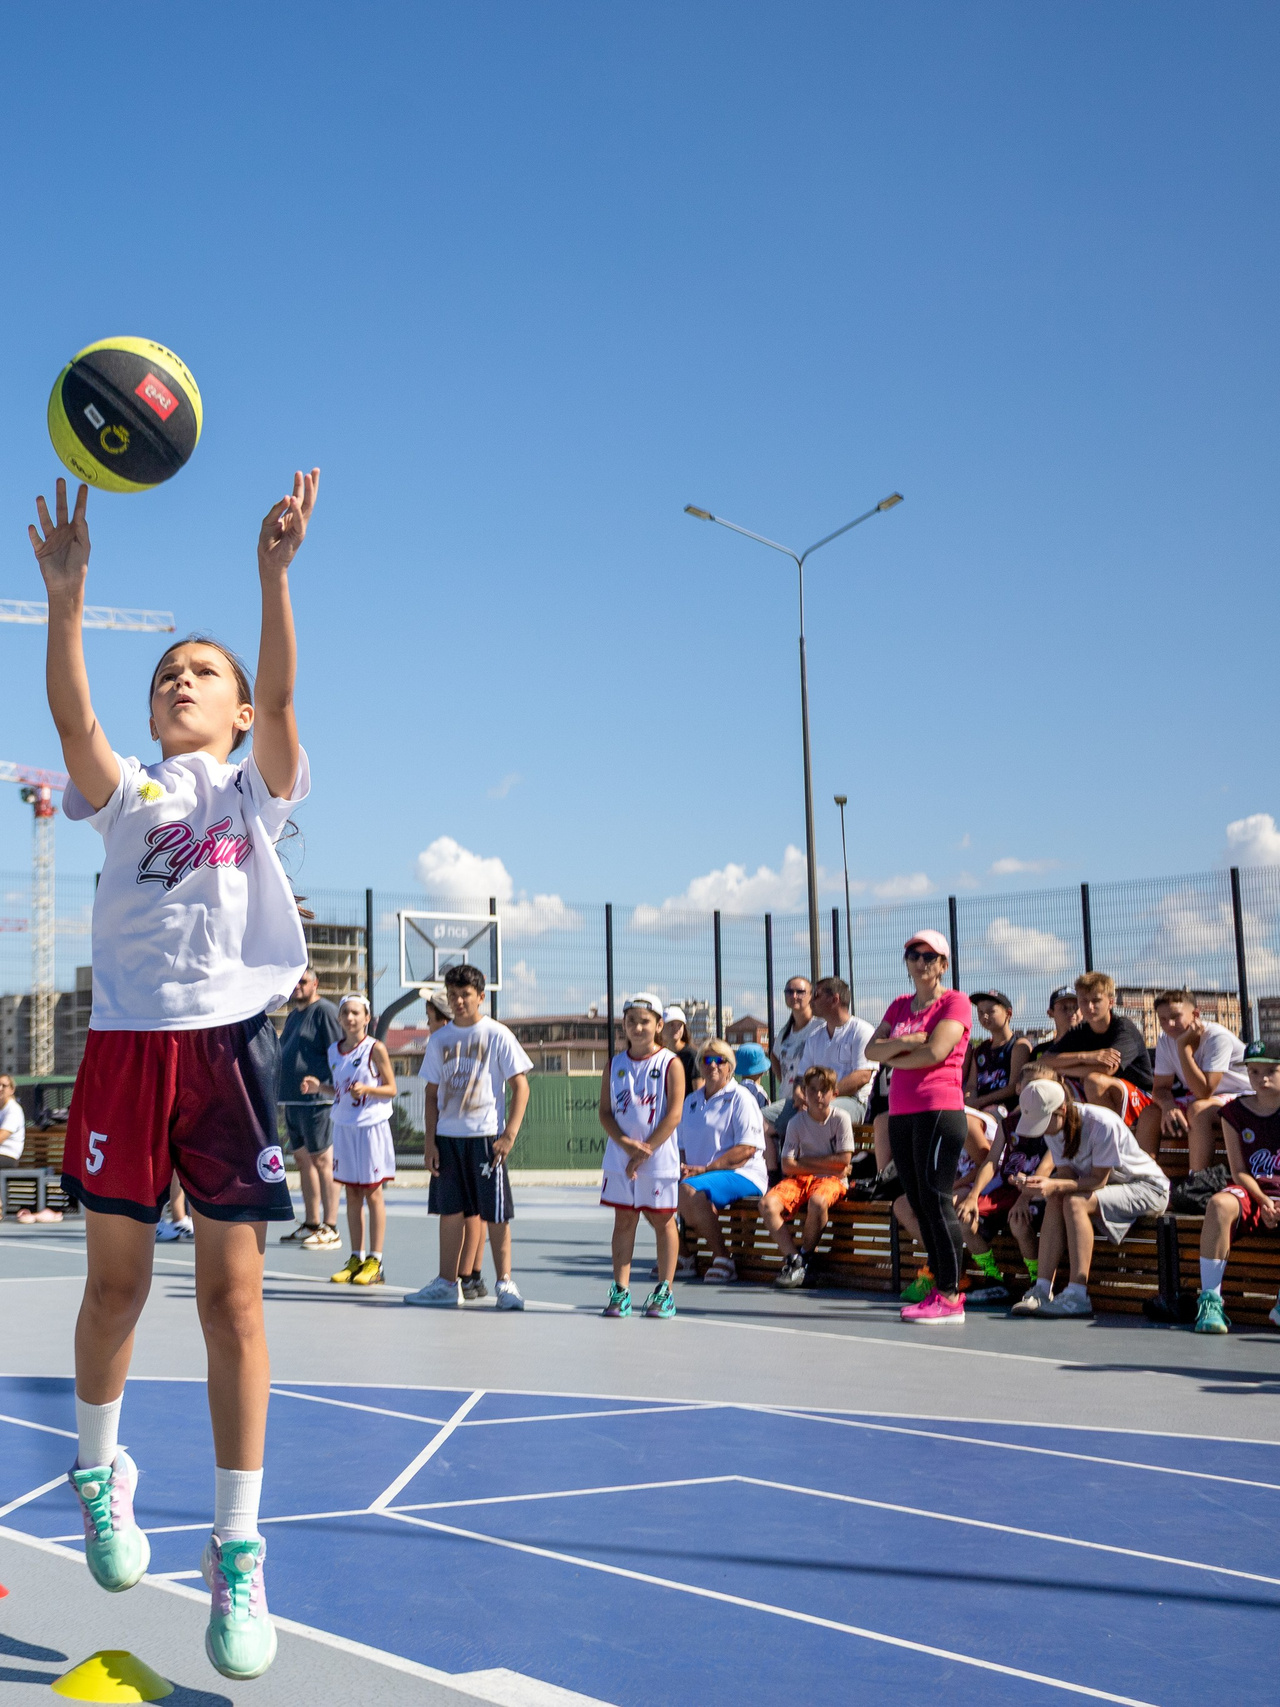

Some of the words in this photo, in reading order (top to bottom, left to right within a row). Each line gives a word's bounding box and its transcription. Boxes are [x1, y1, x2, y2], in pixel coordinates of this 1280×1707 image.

[136, 816, 253, 891] Рубин
[647, 1108, 656, 1125] 1
[85, 1131, 109, 1177] 5
